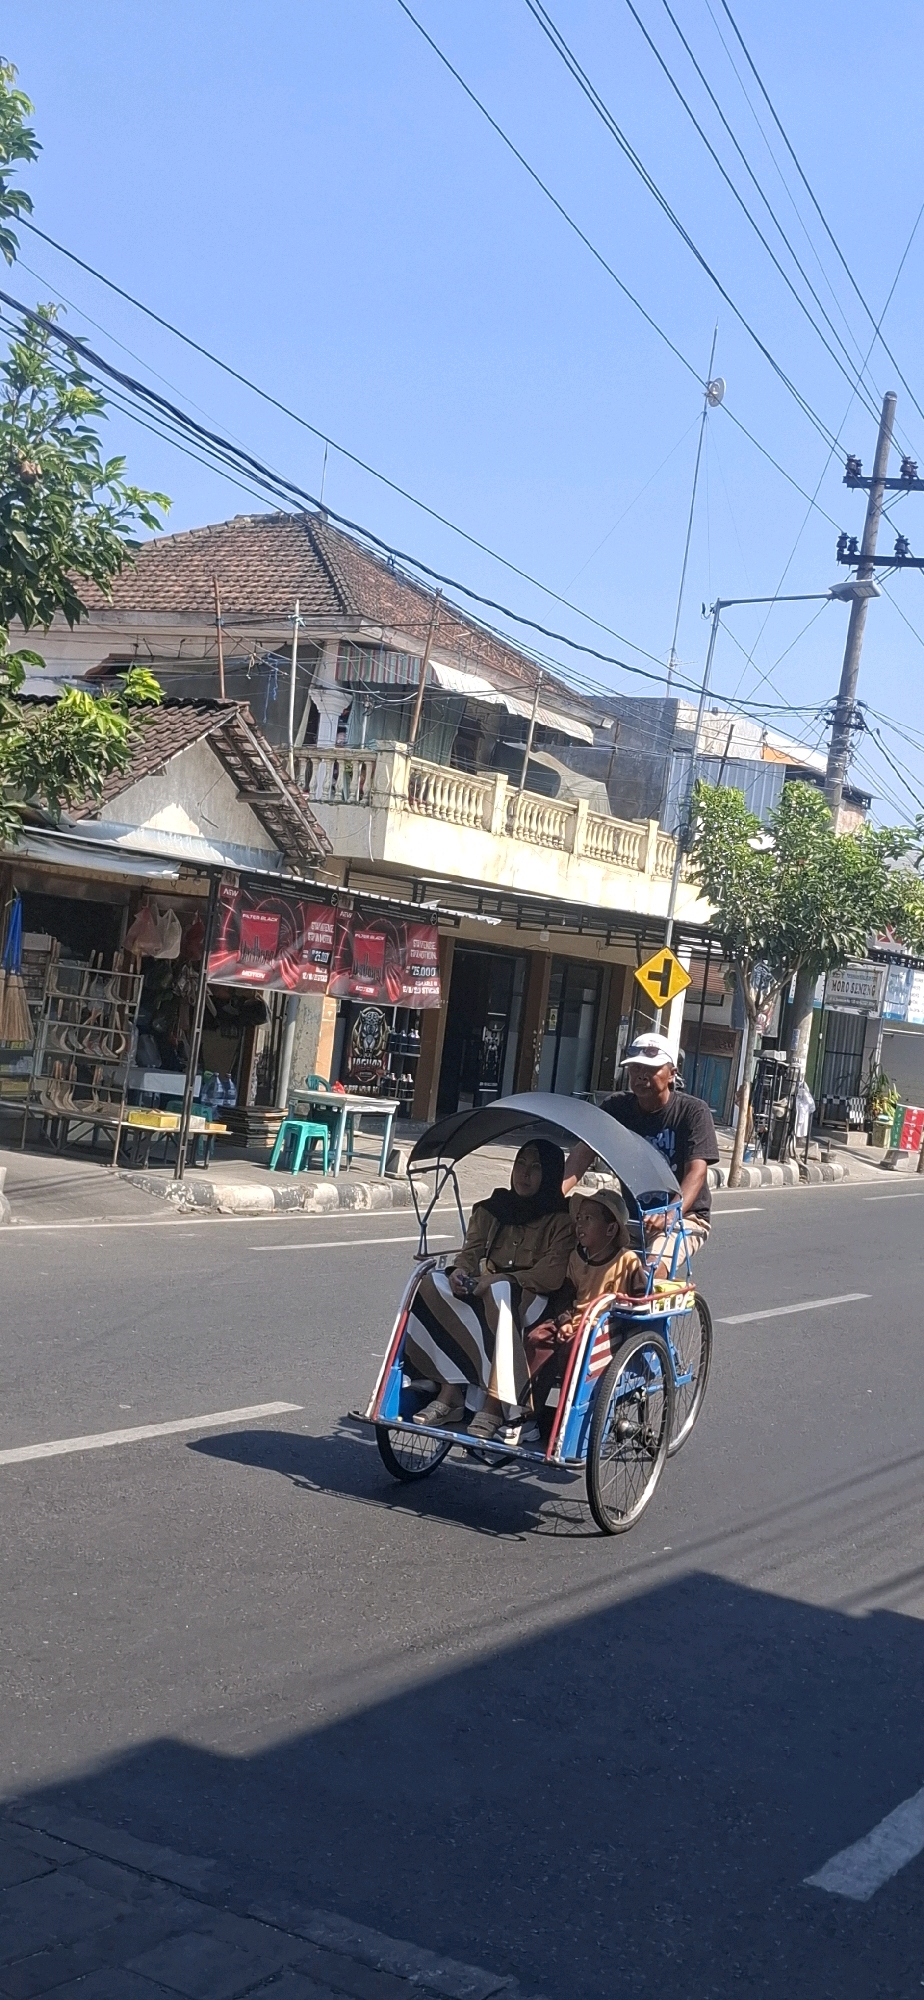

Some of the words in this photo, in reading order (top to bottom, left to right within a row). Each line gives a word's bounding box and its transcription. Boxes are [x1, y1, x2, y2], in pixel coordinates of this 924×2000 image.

[223, 887, 239, 897] NEW
[242, 913, 260, 921] FILTER
[831, 980, 850, 993] MORO
